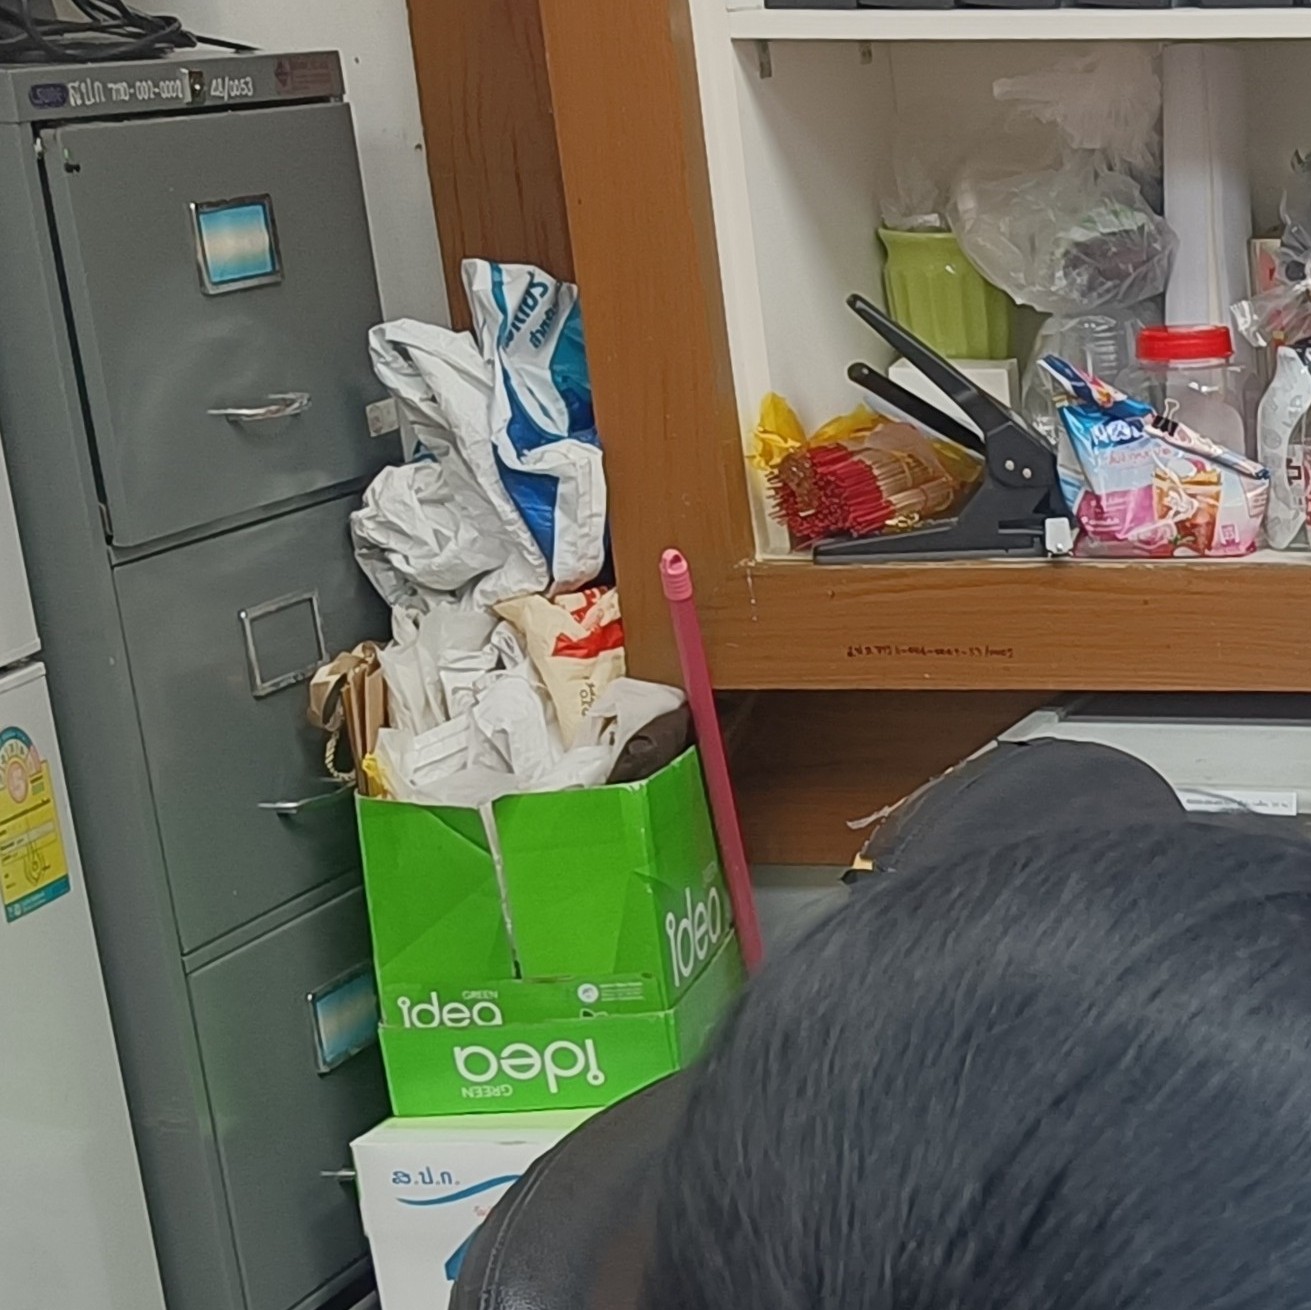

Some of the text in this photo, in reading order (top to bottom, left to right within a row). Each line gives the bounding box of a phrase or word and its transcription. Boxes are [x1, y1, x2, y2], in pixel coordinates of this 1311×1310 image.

[666, 886, 721, 988] idea
[397, 991, 503, 1028] idea
[461, 990, 498, 1000] GREEN
[453, 1038, 606, 1094] idea
[461, 1084, 513, 1098] GREEN
